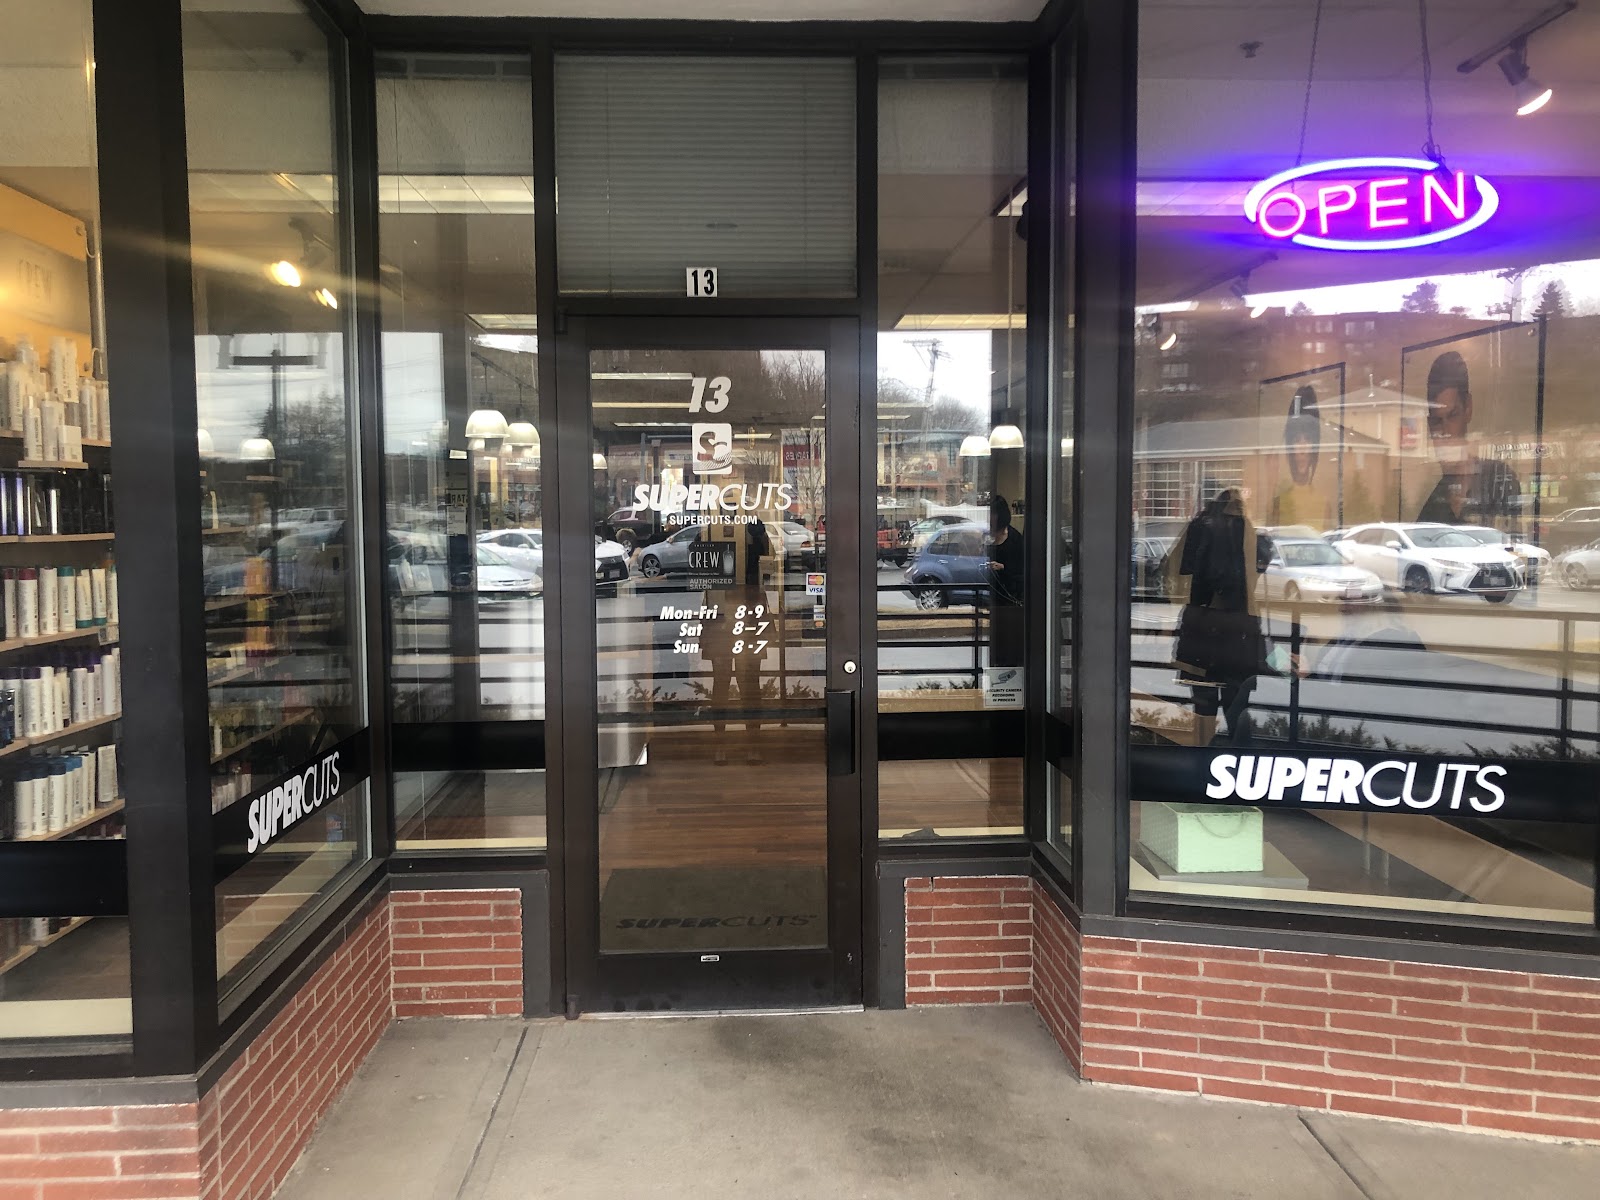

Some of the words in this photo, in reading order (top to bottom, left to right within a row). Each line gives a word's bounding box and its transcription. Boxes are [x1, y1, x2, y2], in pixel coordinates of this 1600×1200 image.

[1258, 170, 1465, 237] OPEN
[691, 269, 715, 296] 13
[688, 376, 732, 413] 13
[633, 483, 793, 511] SUPERCUTS
[669, 515, 758, 526] SUPERCUTS.COM
[688, 551, 720, 569] CREW
[660, 604, 718, 620] Mon-Fri
[734, 605, 765, 619] 8-9
[679, 622, 703, 637] Sat
[673, 640, 700, 654] Sun
[1205, 754, 1508, 813] SUPERCUTS
[247, 751, 340, 854] SUPERCUTS
[616, 915, 810, 929] SUPERCUTS
